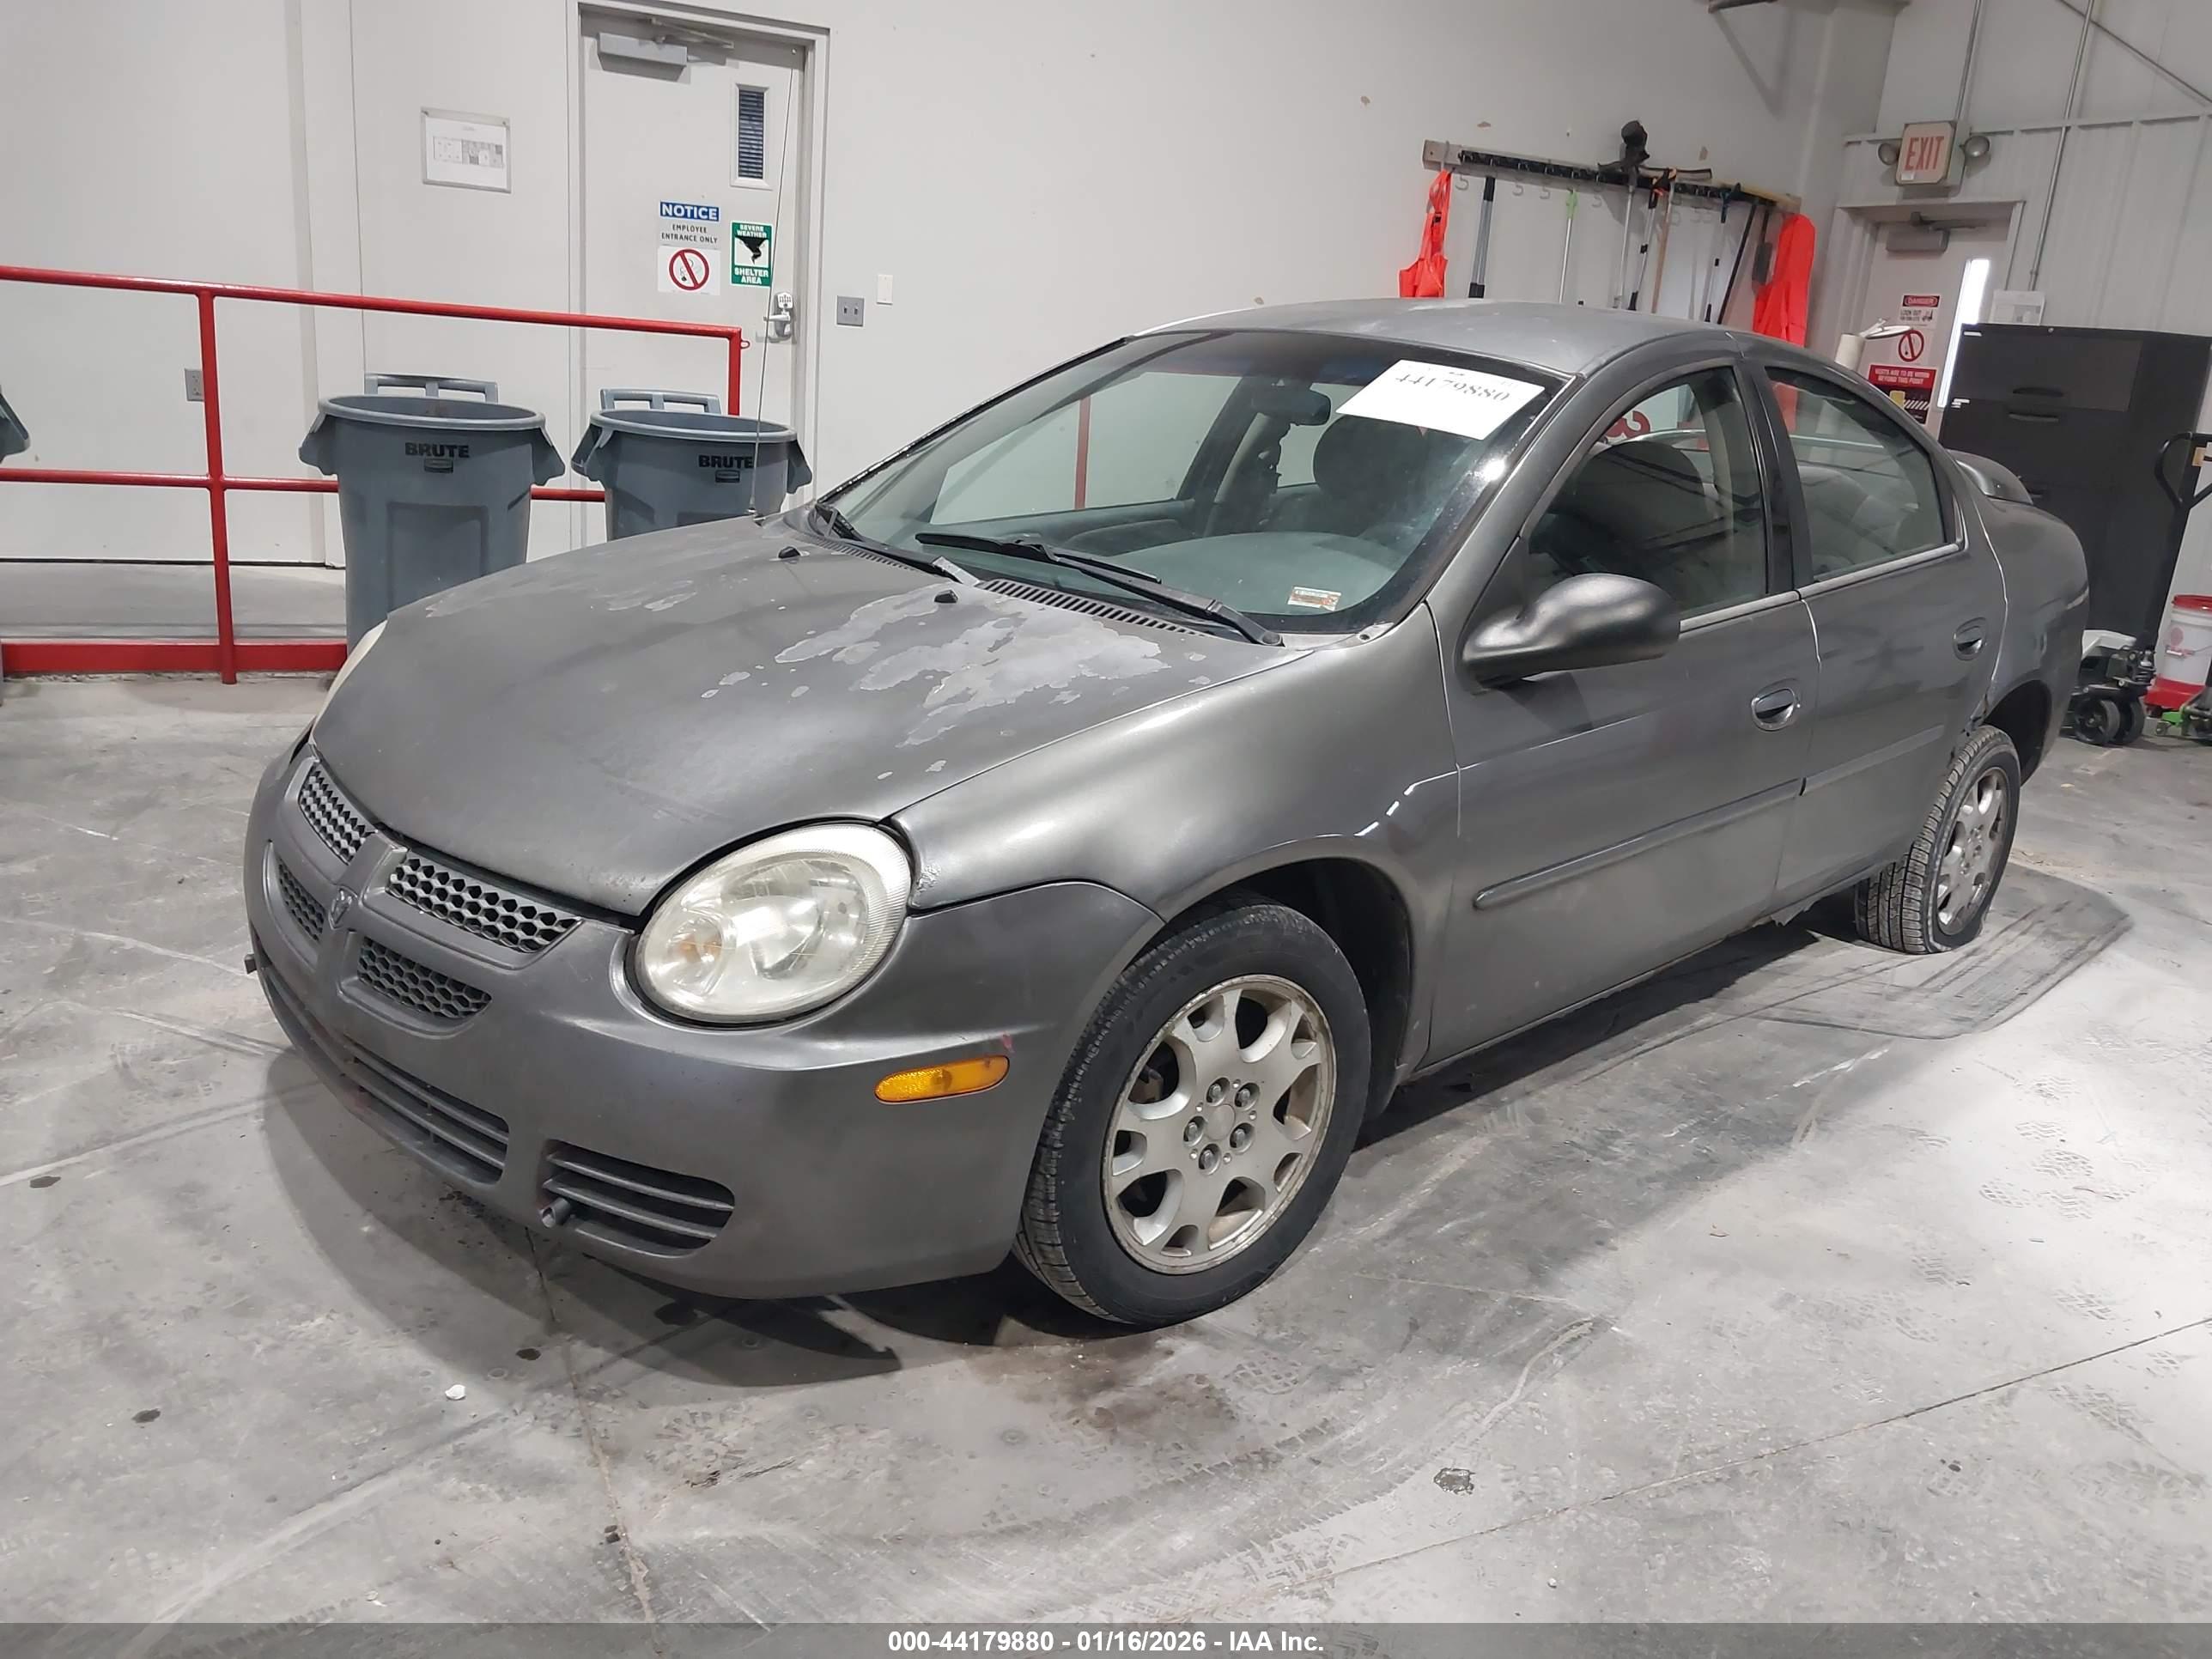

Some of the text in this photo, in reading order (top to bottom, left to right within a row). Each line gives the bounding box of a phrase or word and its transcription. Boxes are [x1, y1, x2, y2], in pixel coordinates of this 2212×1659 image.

[1905, 136, 1945, 171] EXIT
[662, 204, 718, 221] NOTICE
[672, 224, 707, 234] EMPLOYEE
[737, 230, 767, 239] WEATHER
[661, 233, 697, 242] ENTRANCE
[734, 267, 769, 278] SHELTER
[741, 276, 762, 284] AREA
[405, 442, 470, 459] BRUTE
[699, 455, 755, 469] BRUTE
